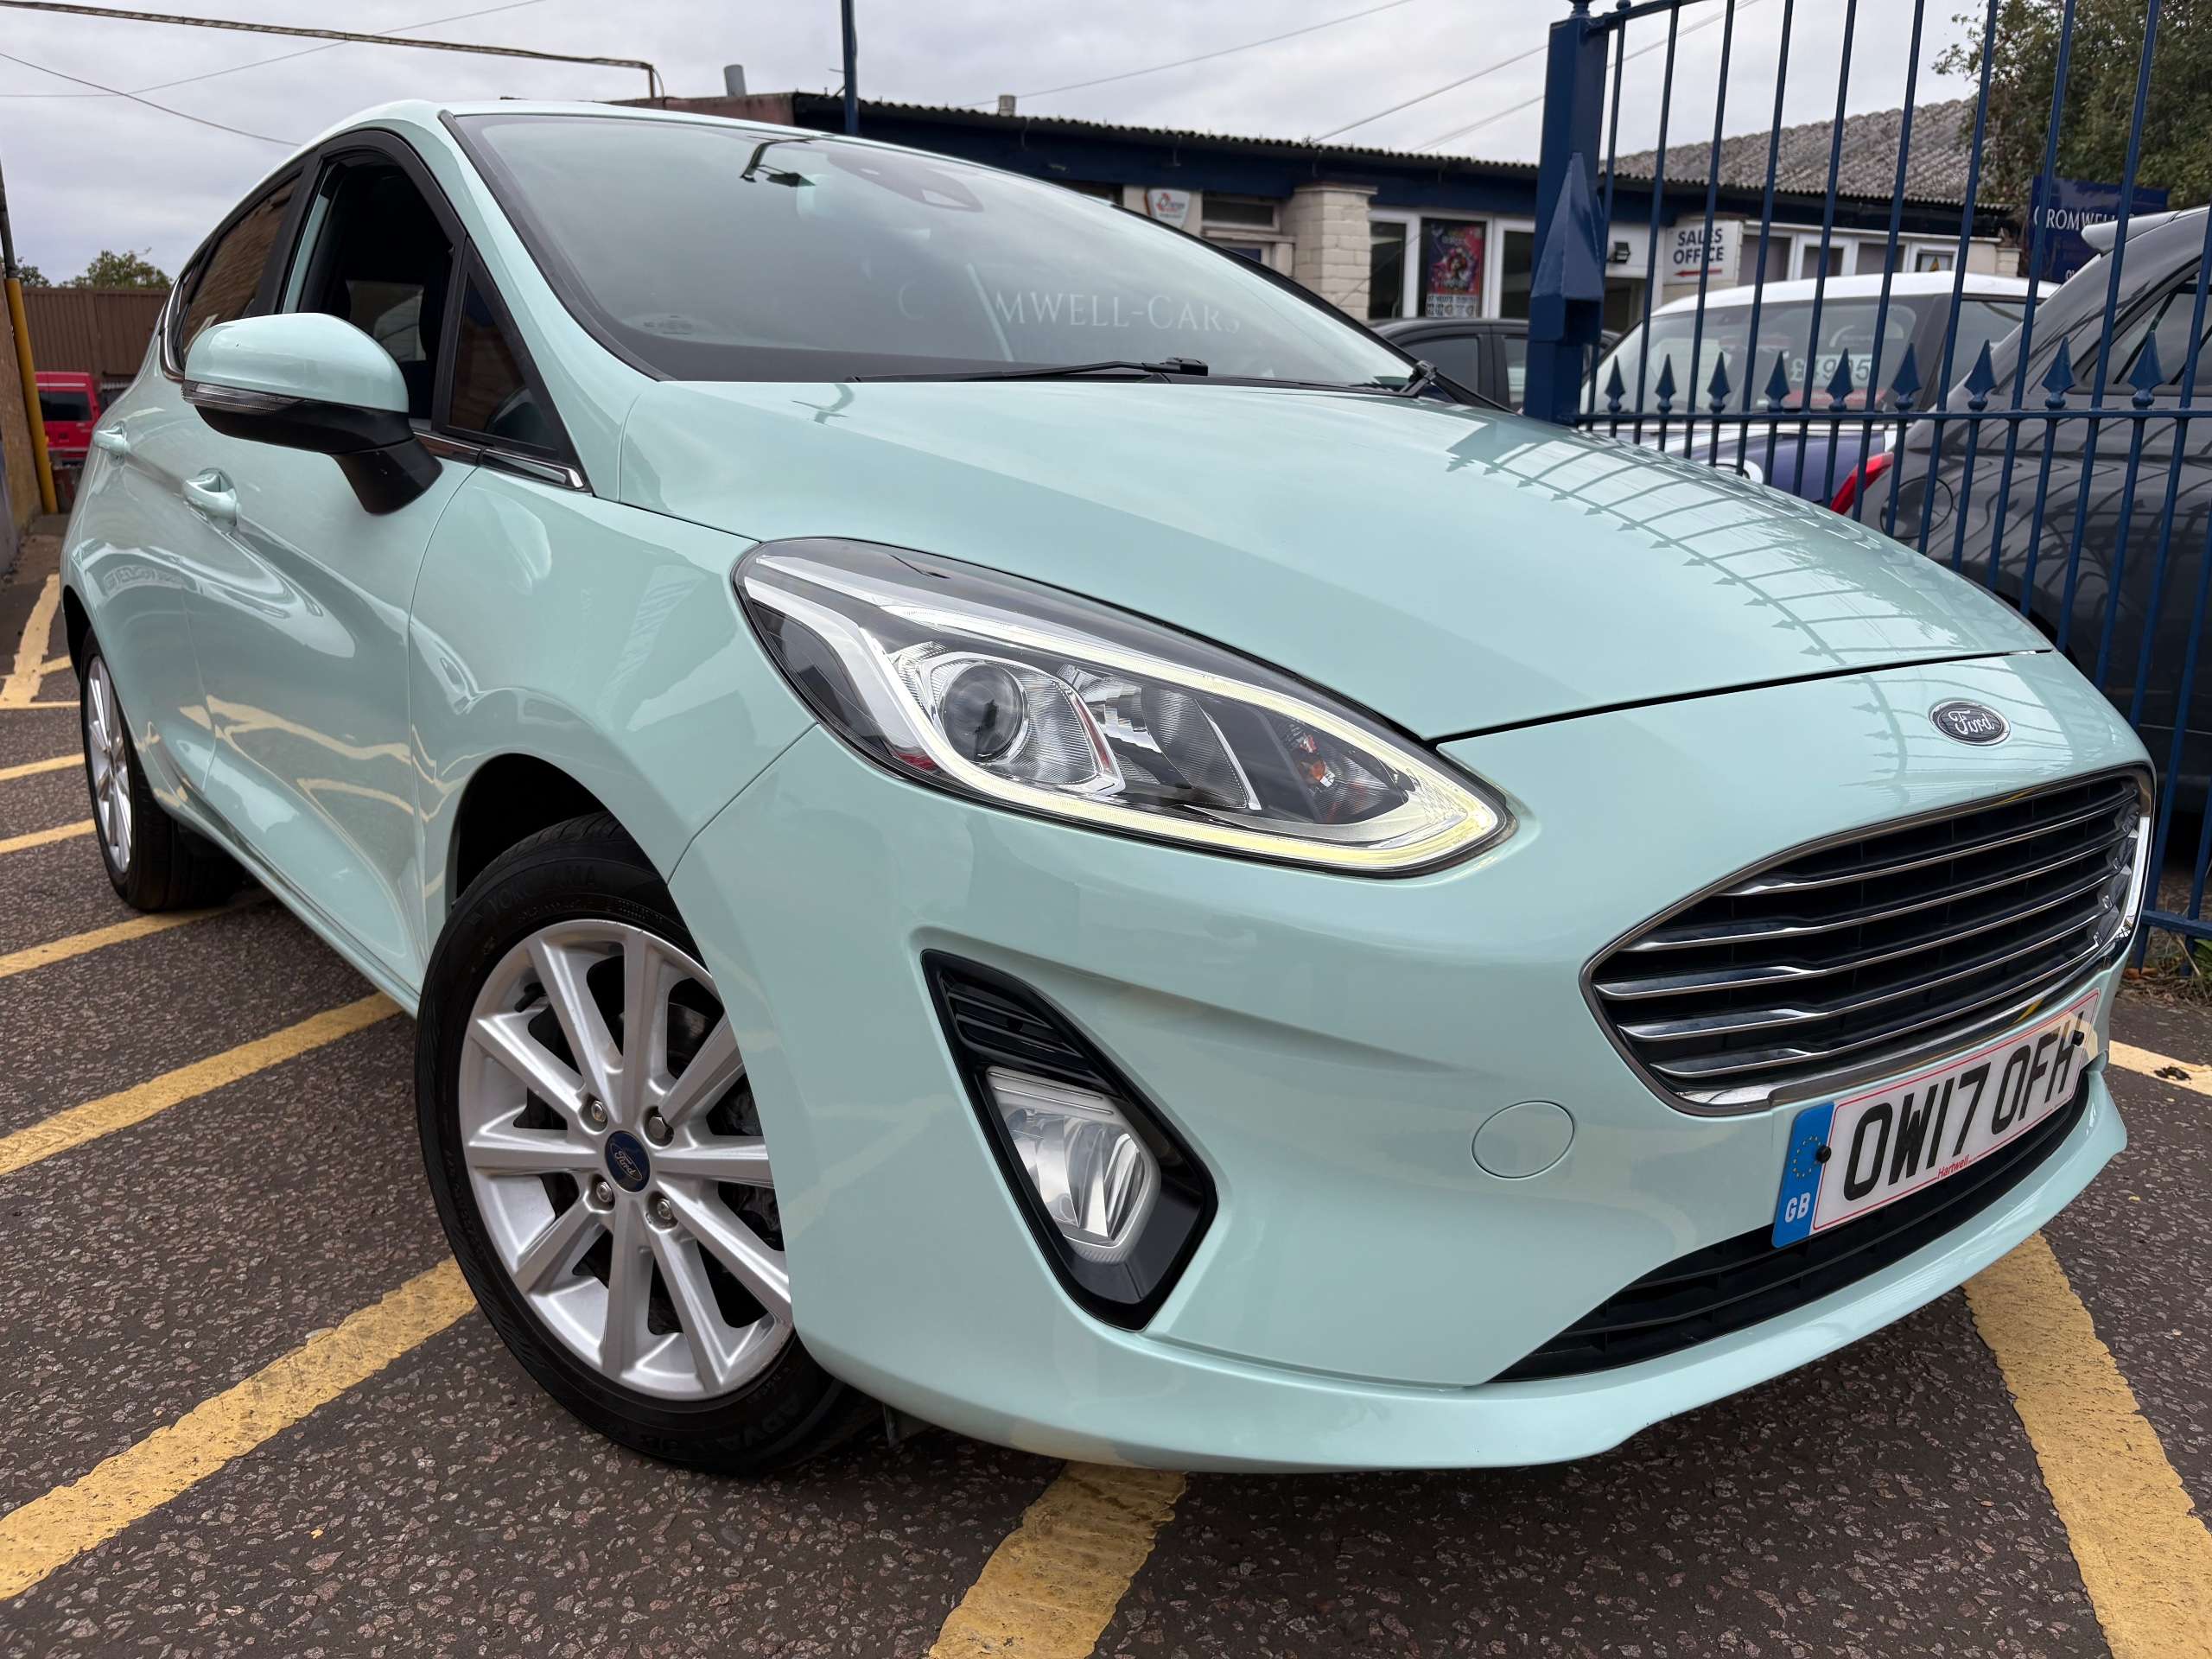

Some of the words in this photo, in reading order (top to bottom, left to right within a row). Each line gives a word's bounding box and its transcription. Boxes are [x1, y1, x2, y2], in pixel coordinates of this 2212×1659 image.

[1677, 227, 1723, 247] SALS
[1673, 245, 1725, 264] OFFCE
[898, 281, 1241, 335] CMWELL-CARS
[1789, 357, 1872, 382] £95
[1948, 709, 1995, 735] Ford
[1843, 1061, 1991, 1202] OW17
[1991, 1010, 2085, 1135] OFH
[614, 1149, 638, 1176] Ford
[1937, 1154, 1970, 1179] Hartwell
[1784, 1192, 1811, 1224] GB
